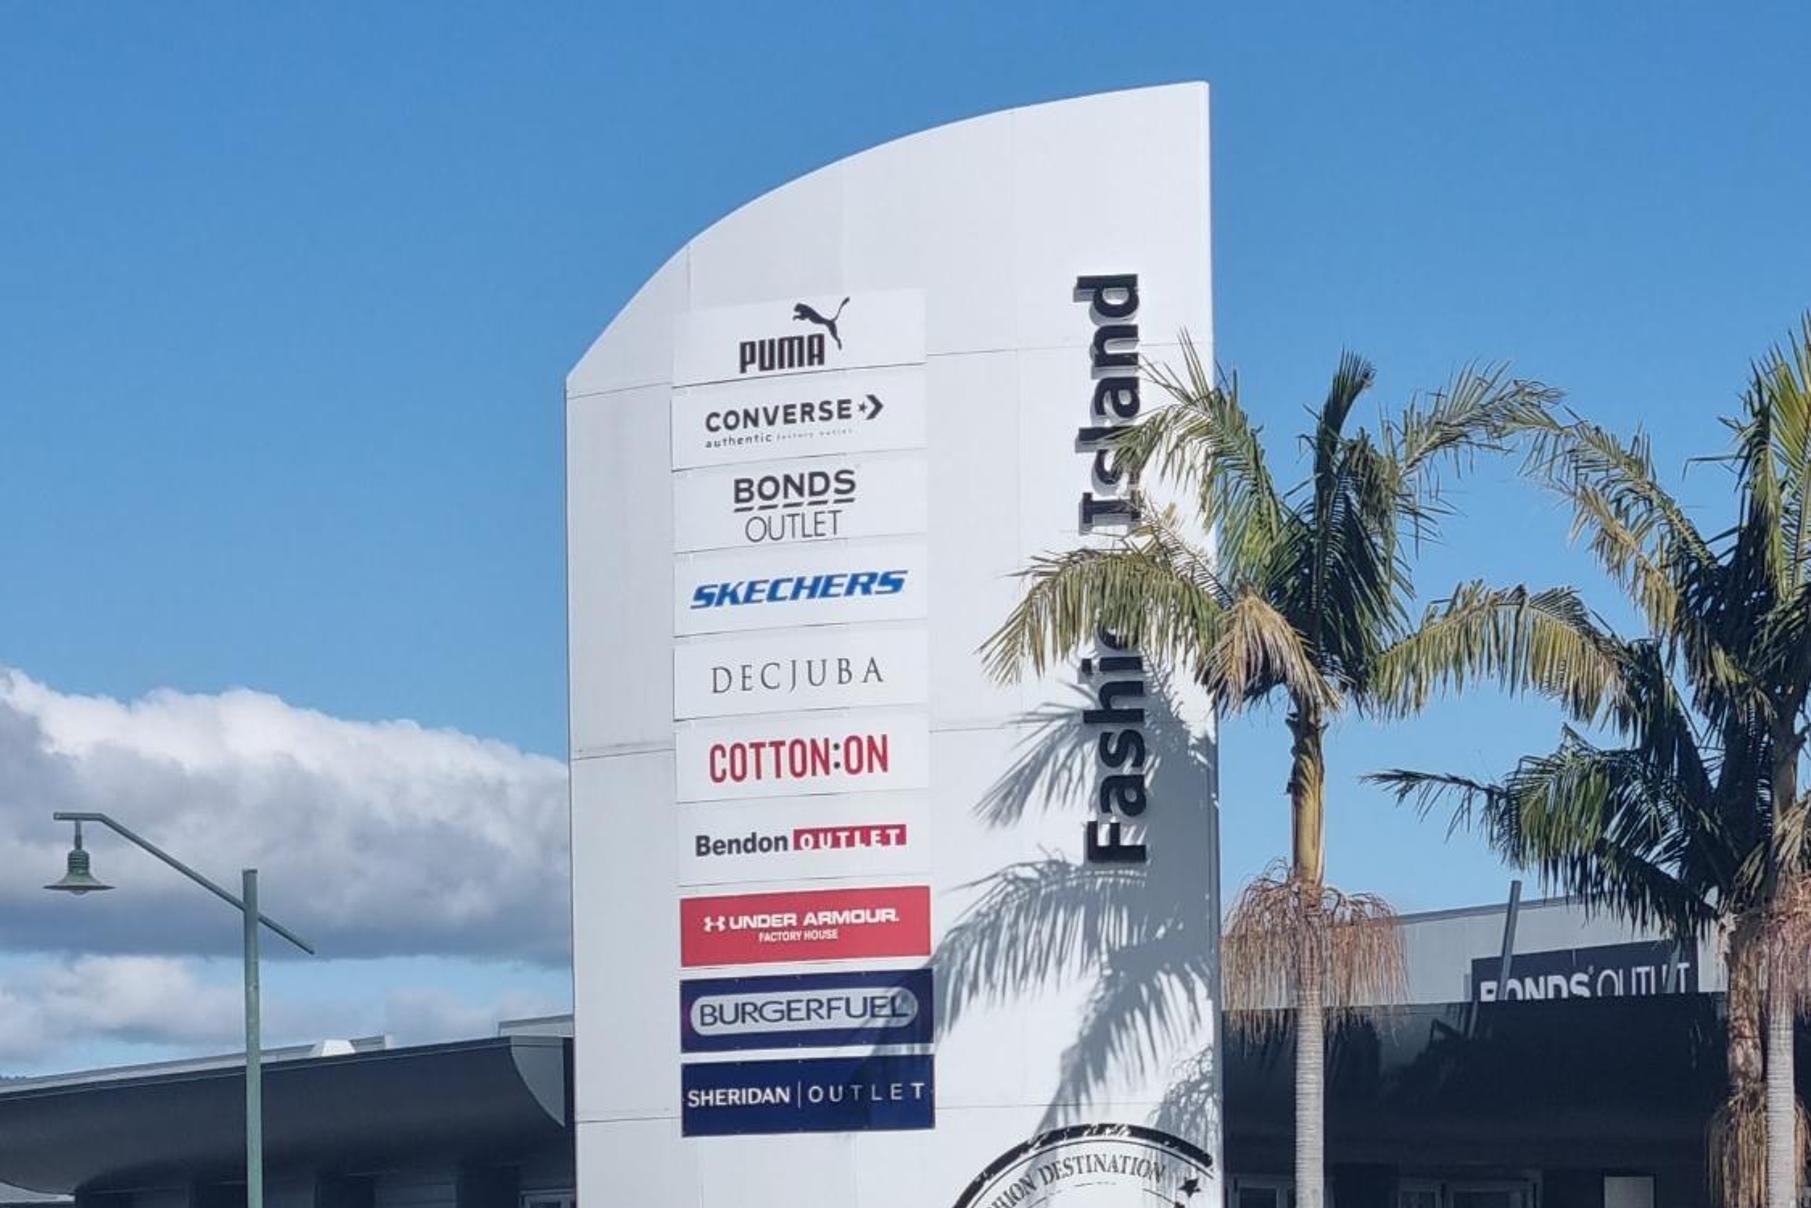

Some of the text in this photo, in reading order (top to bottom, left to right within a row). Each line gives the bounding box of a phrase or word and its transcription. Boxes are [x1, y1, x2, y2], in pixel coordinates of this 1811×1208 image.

[739, 333, 825, 374] PUMA
[705, 398, 853, 433] CONVERSE
[705, 432, 772, 448] authentic
[733, 469, 856, 504] BONDS
[745, 510, 842, 542] OUTLET
[1074, 274, 1148, 863] Fashi Island
[690, 570, 908, 609] SKECHERS
[711, 656, 884, 694] DECJUBA
[709, 734, 888, 784] COTTON:ON
[695, 828, 901, 857] Bendon OUTLET
[729, 908, 900, 930] UNDER ARMOUR
[758, 929, 838, 943] FACTORY HOUSE
[700, 995, 910, 1027] BURGERFUEL
[687, 1082, 926, 1108] SHERIDAN OUTLET
[1038, 1153, 1166, 1186] DESTINATION
